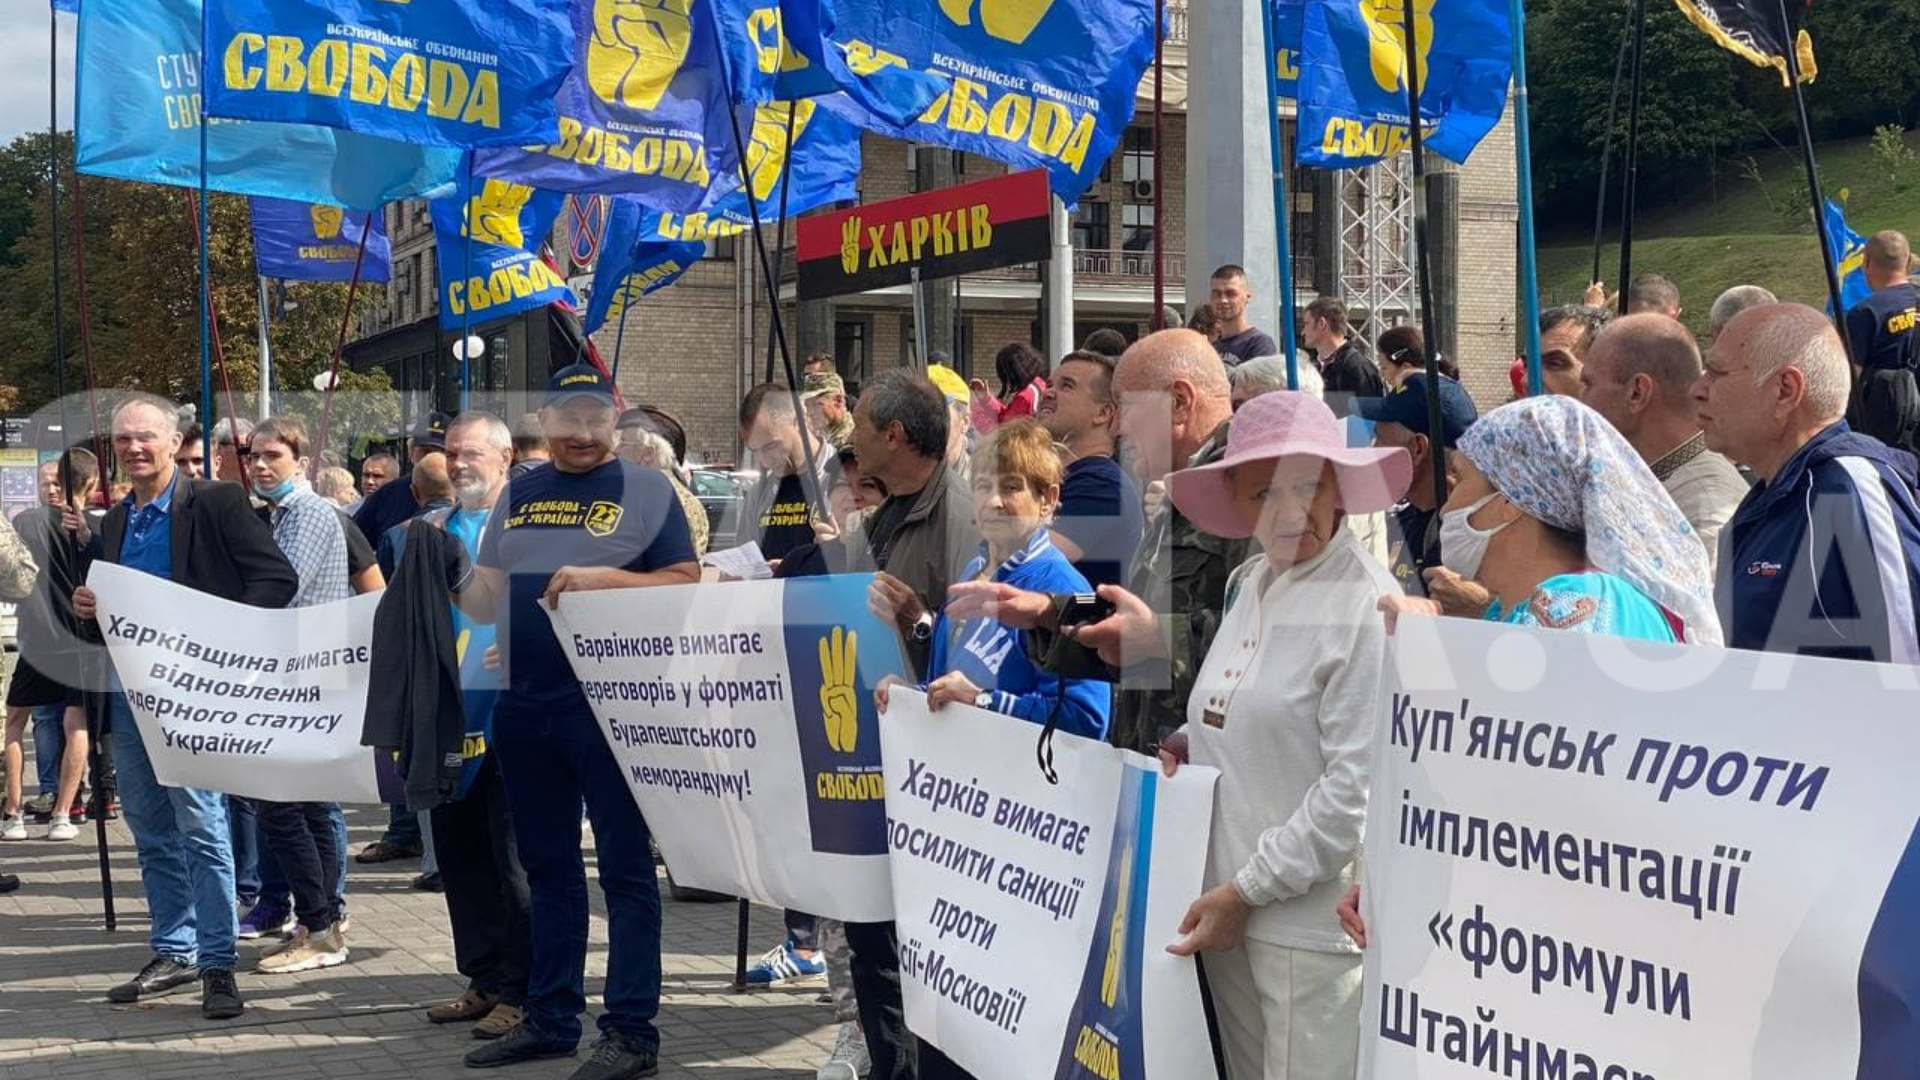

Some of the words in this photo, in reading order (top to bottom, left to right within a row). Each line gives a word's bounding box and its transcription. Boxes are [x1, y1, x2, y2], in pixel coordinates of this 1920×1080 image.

[867, 203, 993, 269] ХАРКІВ
[107, 614, 278, 674] Харківщина
[285, 646, 370, 673] вимагає
[573, 631, 675, 664] Барвінкове
[679, 632, 763, 656] вимагає
[148, 660, 321, 703] відновлення
[681, 682, 692, 708] у
[698, 673, 784, 709] форматі
[160, 726, 274, 756] України!
[244, 711, 343, 734] статусу
[608, 717, 757, 750] Будапештського
[1390, 692, 1617, 777] Куп'янськ
[1626, 737, 1830, 811] проти
[630, 764, 752, 801] меморандуму!
[816, 771, 885, 800] СВОБОД
[899, 758, 990, 819] Харків
[993, 797, 1091, 856] вимагає
[1398, 790, 1752, 920] імплементації
[997, 861, 1085, 922] санкції
[928, 897, 998, 951] проти
[899, 938, 1028, 1035] сії-Московії!
[1427, 904, 1693, 1020] «формули
